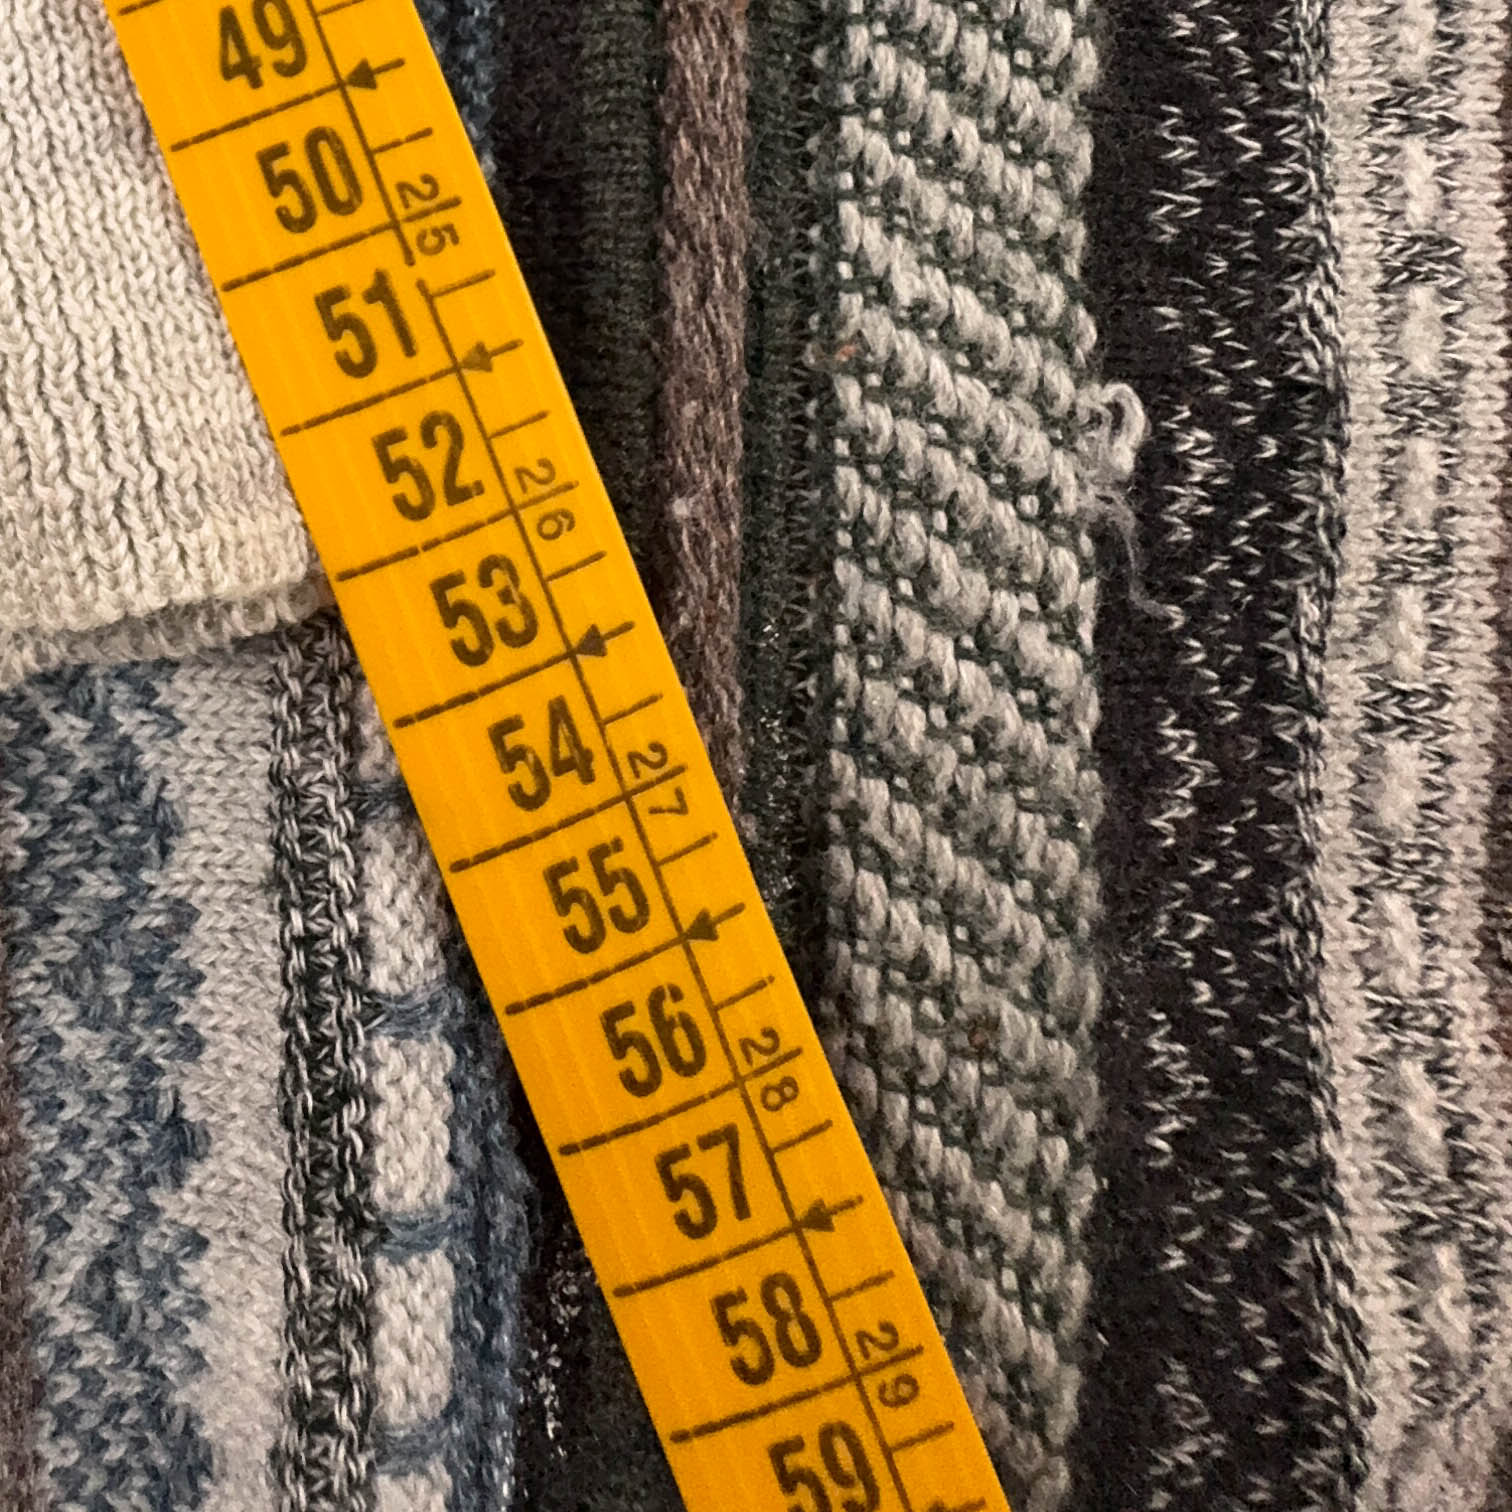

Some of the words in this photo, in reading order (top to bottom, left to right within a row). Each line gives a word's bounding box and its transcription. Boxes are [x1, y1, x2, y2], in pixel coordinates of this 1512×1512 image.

[255, 126, 363, 234] 50
[314, 268, 418, 379] 51
[371, 410, 486, 522] 52
[429, 554, 539, 668] 53
[488, 695, 596, 812] 54
[543, 836, 651, 955] 55
[600, 983, 707, 1098] 56
[655, 1123, 752, 1241] 57
[710, 1272, 823, 1387] 58
[768, 1421, 881, 1512] 59
